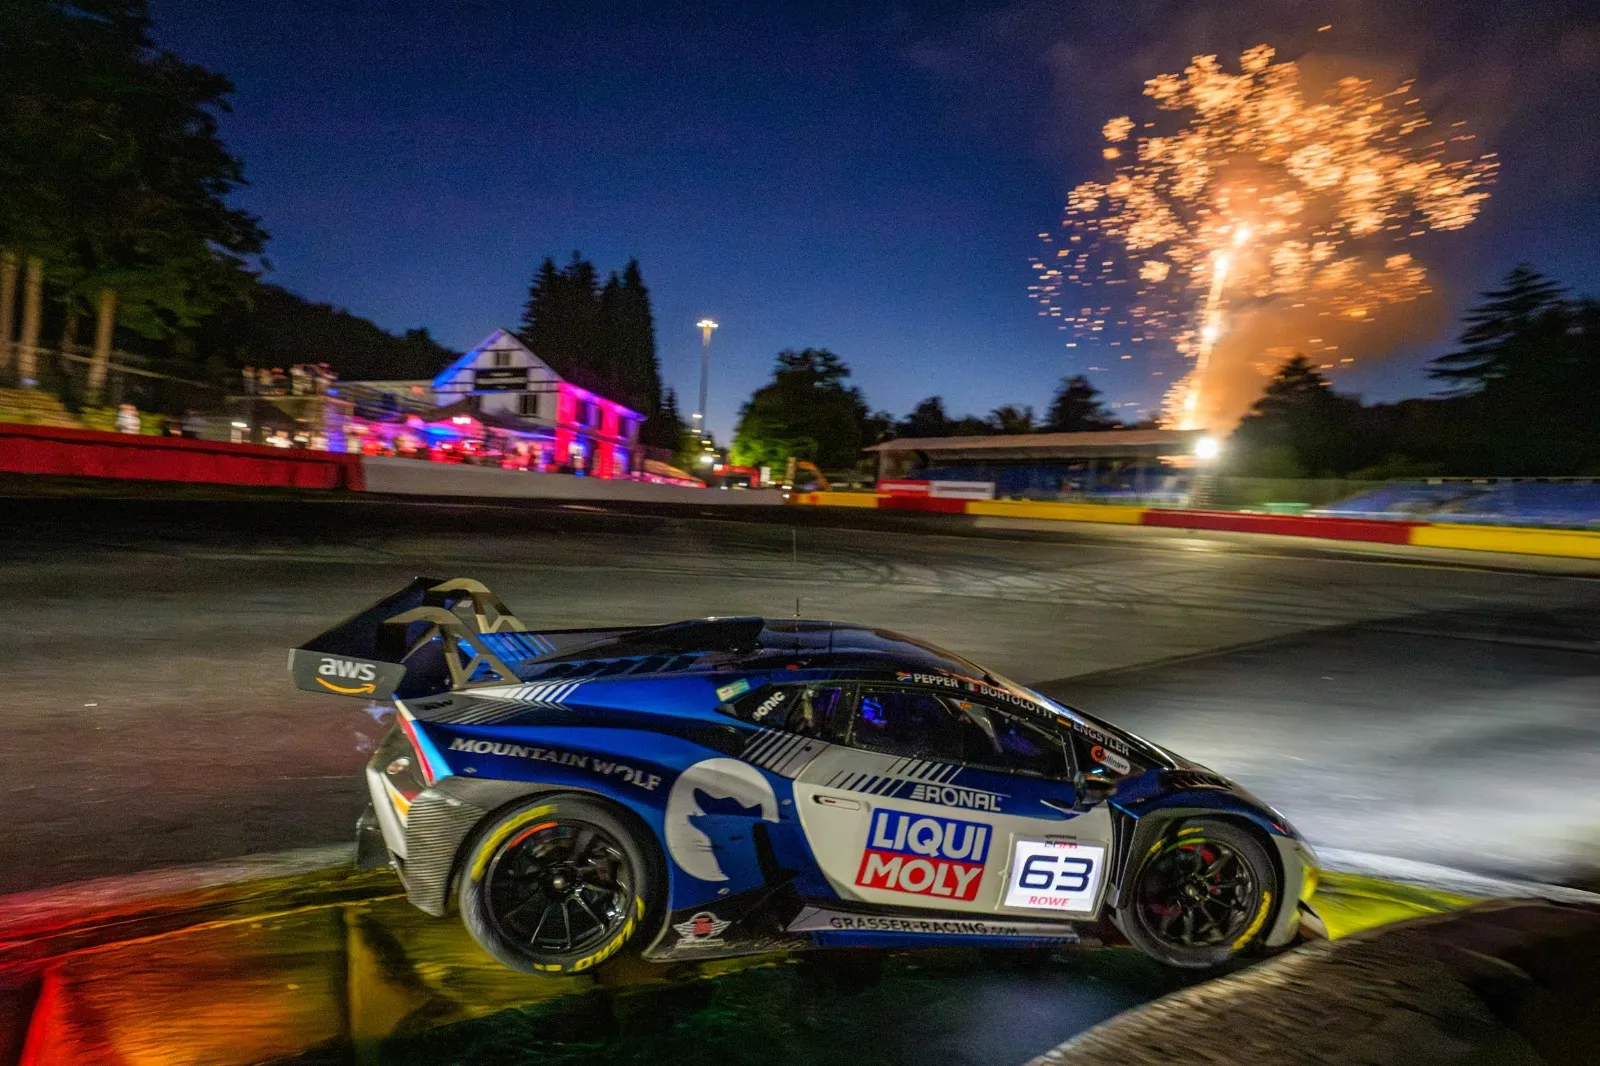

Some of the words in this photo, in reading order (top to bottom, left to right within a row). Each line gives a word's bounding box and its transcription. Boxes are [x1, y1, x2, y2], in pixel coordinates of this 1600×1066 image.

[319, 658, 377, 681] aws
[913, 673, 960, 688] PEPPER
[1073, 721, 1130, 756] ENGSTLER
[448, 737, 590, 768] MOUNTAIN
[593, 758, 662, 791] WOLF
[925, 785, 1001, 811] RONAL
[872, 812, 987, 861] LIQUI
[861, 853, 982, 898] MOLY
[1018, 854, 1094, 892] 63
[1028, 895, 1071, 907] ROWE
